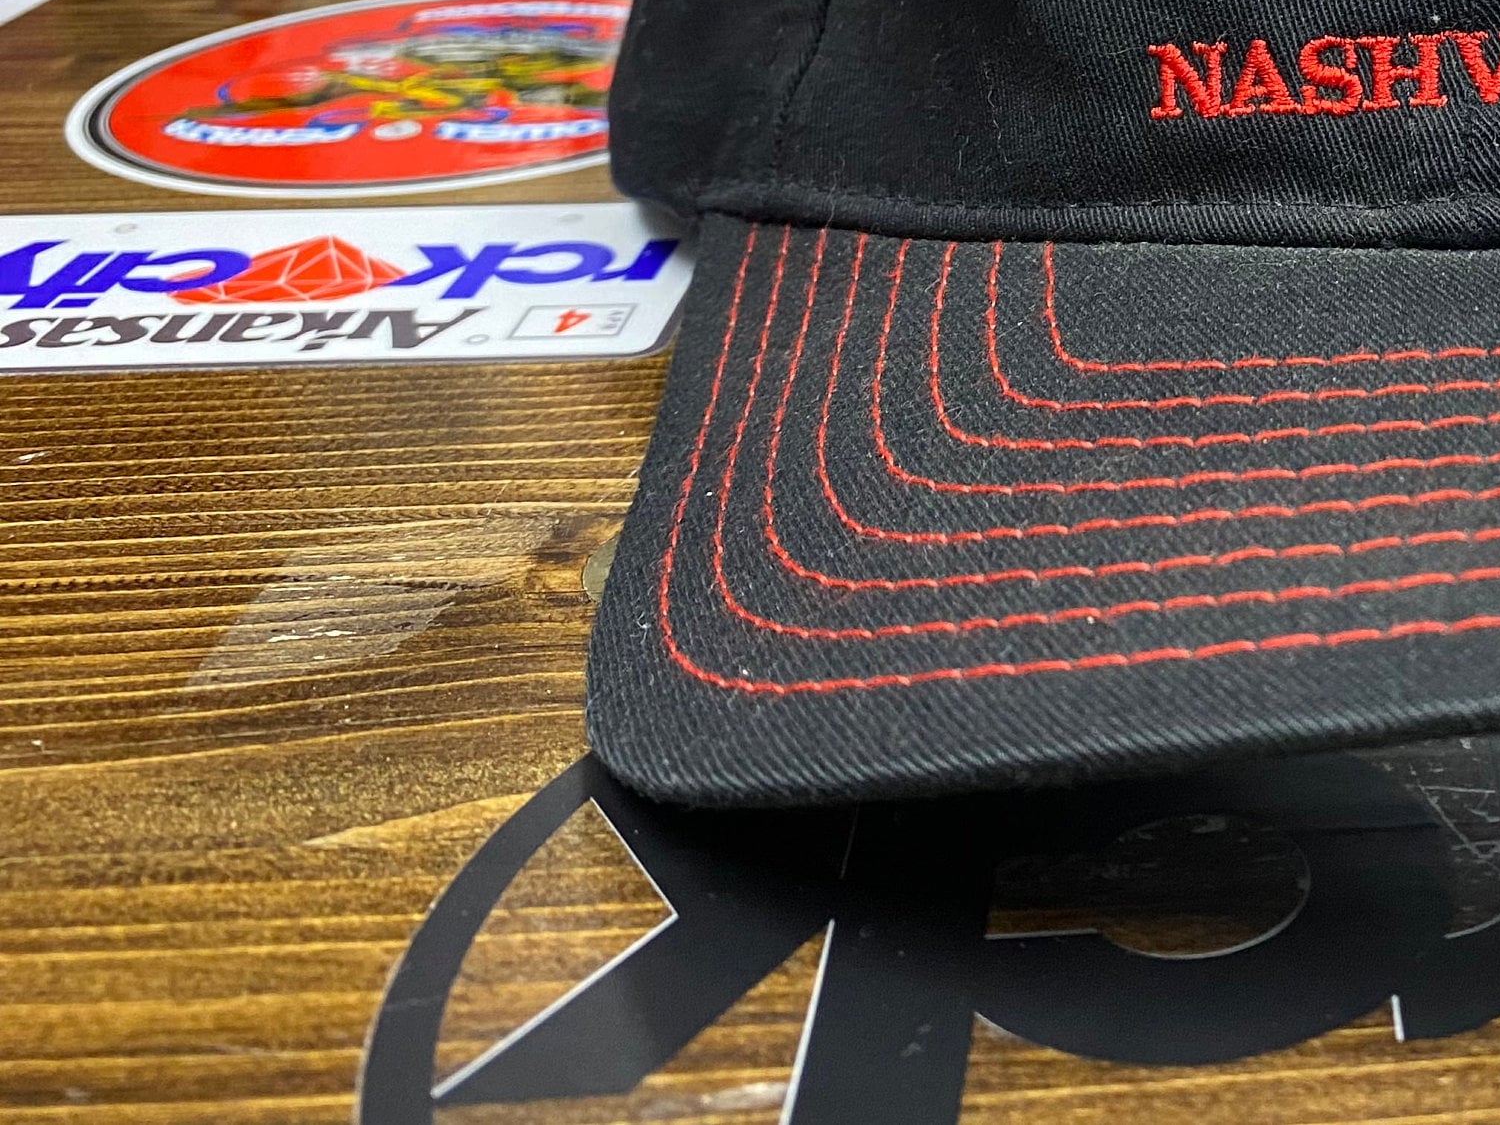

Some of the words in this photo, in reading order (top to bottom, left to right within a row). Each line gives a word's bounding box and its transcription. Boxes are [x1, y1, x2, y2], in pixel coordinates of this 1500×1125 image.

[383, 239, 681, 301] rck
[0, 311, 488, 350] Arkansas
[553, 309, 591, 334] 4
